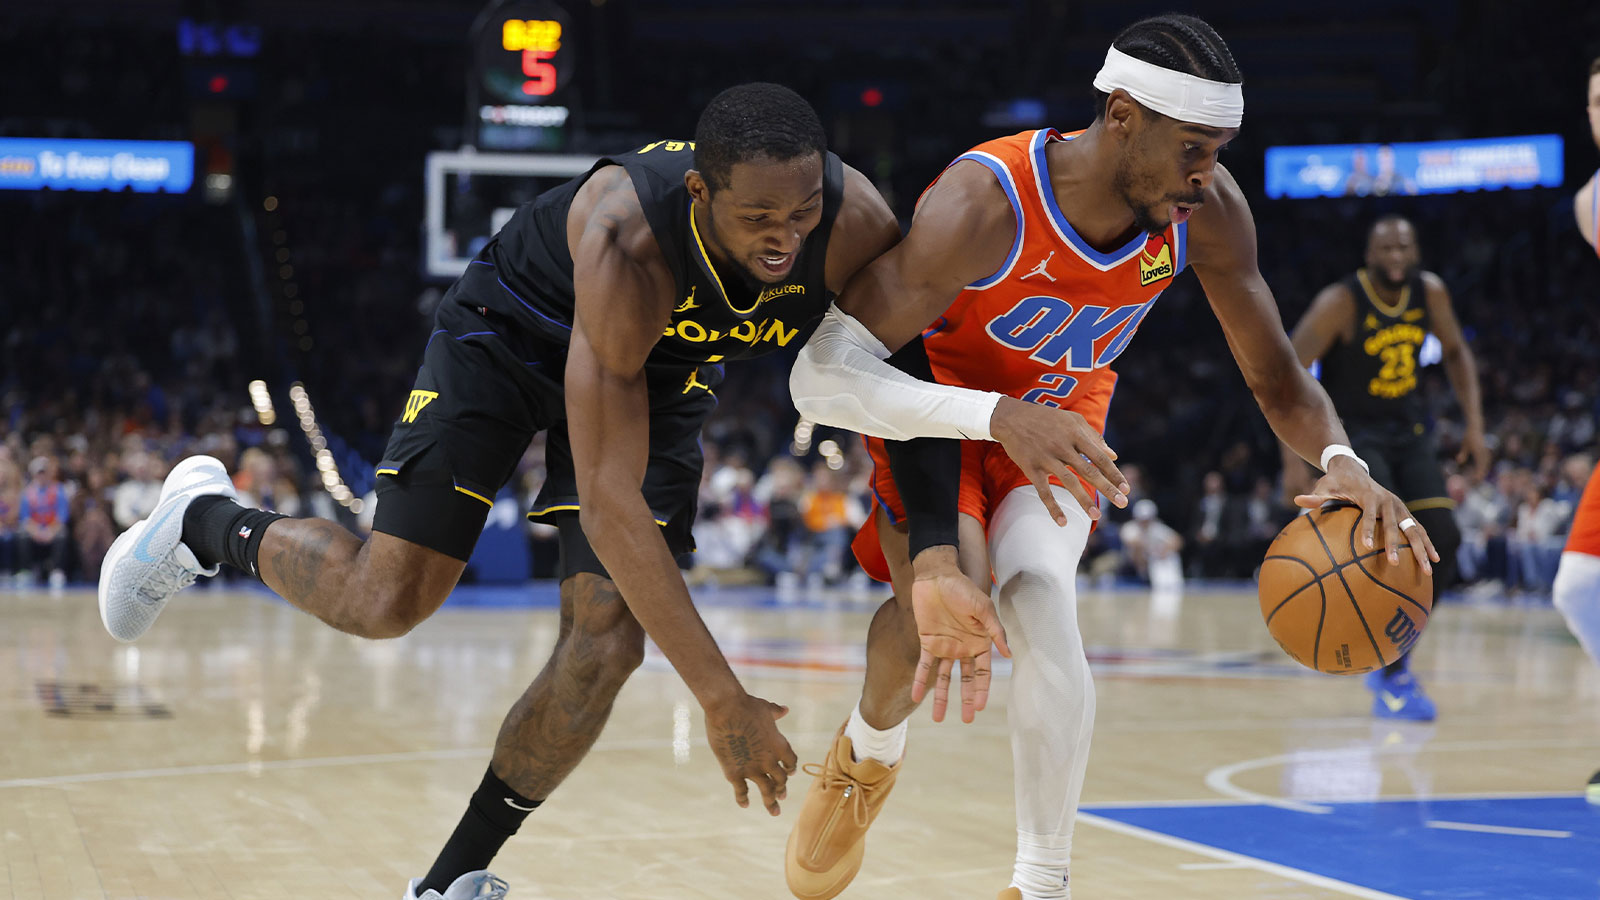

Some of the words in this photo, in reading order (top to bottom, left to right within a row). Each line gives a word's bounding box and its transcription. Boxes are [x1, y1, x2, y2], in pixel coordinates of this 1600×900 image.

[522, 49, 557, 96] 5
[760, 284, 806, 302] akuten
[1379, 343, 1416, 380] 23
[1021, 373, 1078, 409] 2
